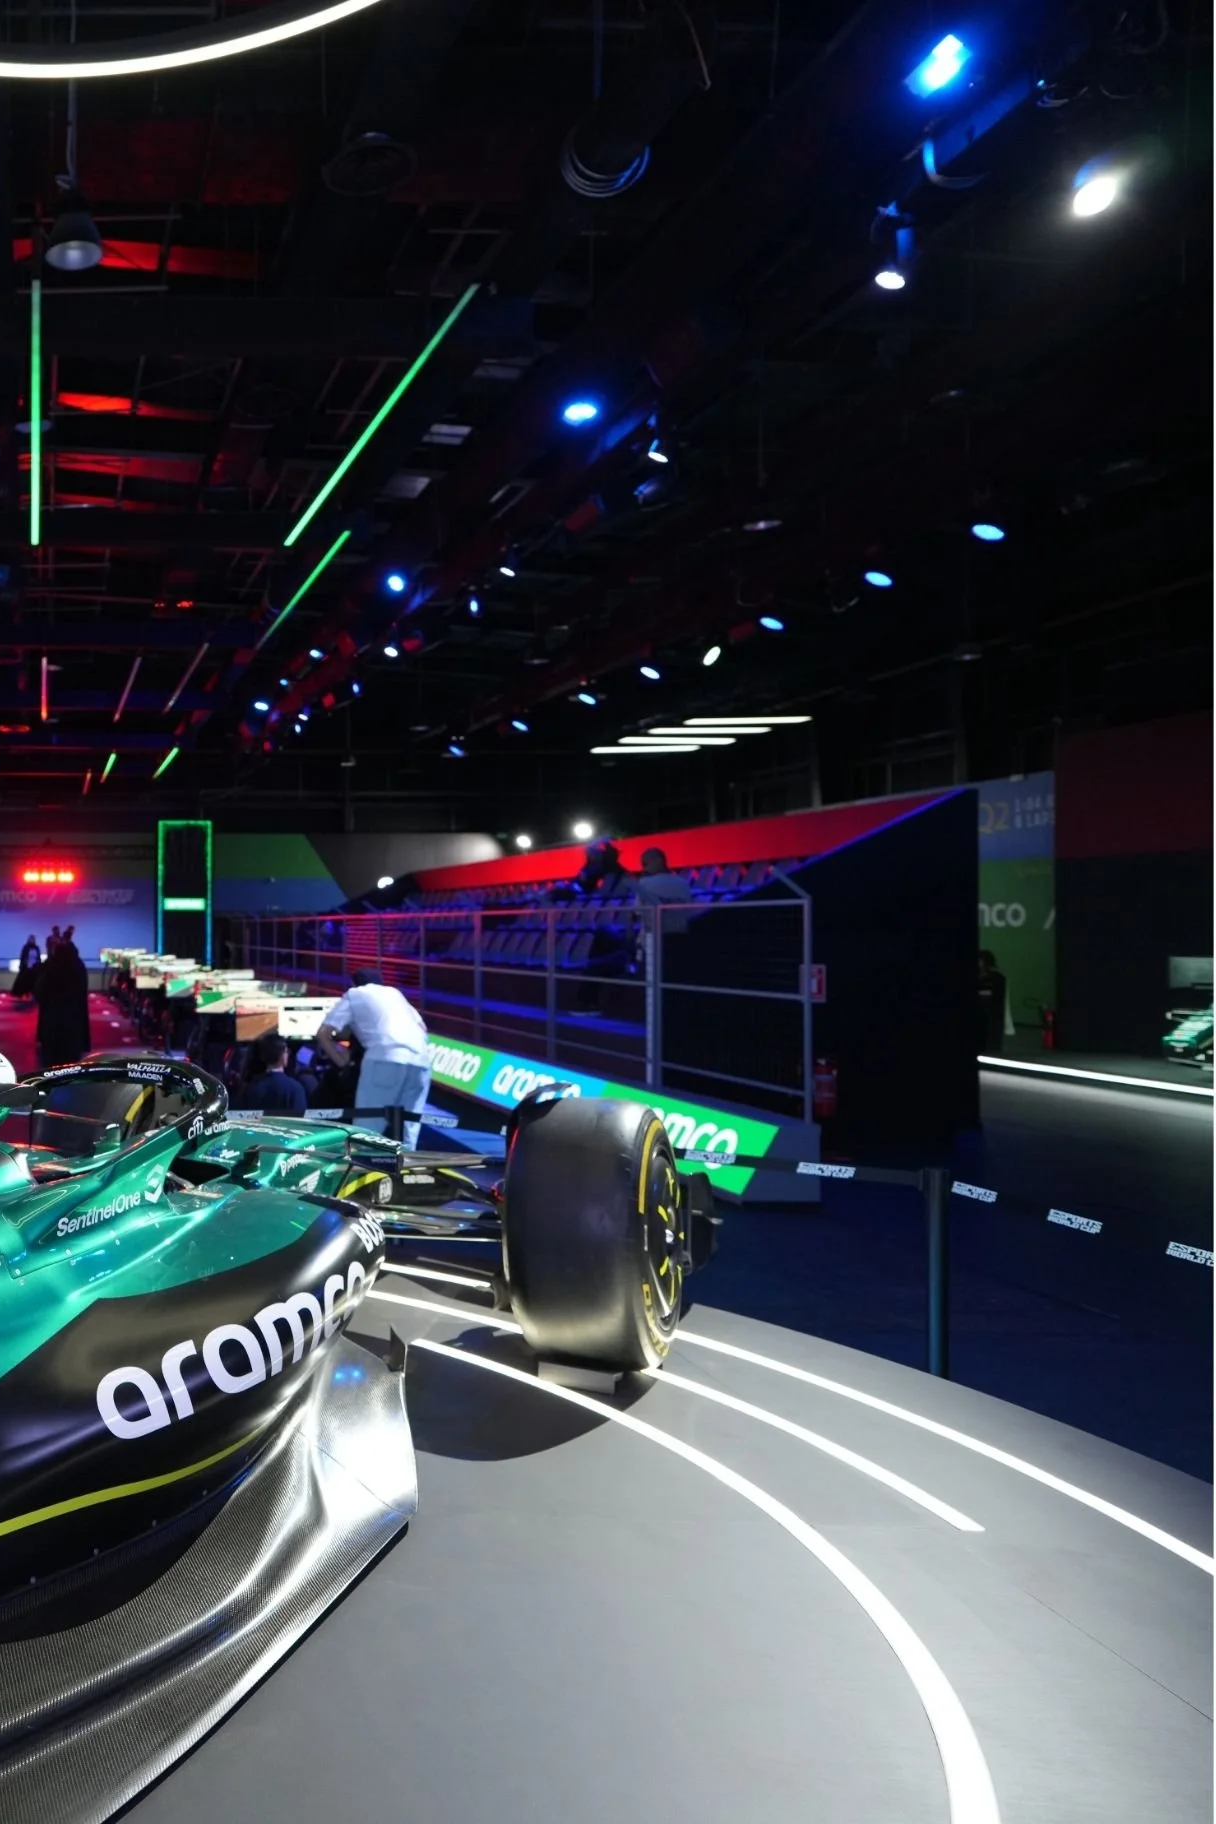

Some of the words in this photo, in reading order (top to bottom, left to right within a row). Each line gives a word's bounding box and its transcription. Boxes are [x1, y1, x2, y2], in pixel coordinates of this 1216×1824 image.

[44, 1066, 82, 1077] aramco
[56, 1191, 141, 1237] SentinelOne
[96, 1261, 366, 1440] aramco
